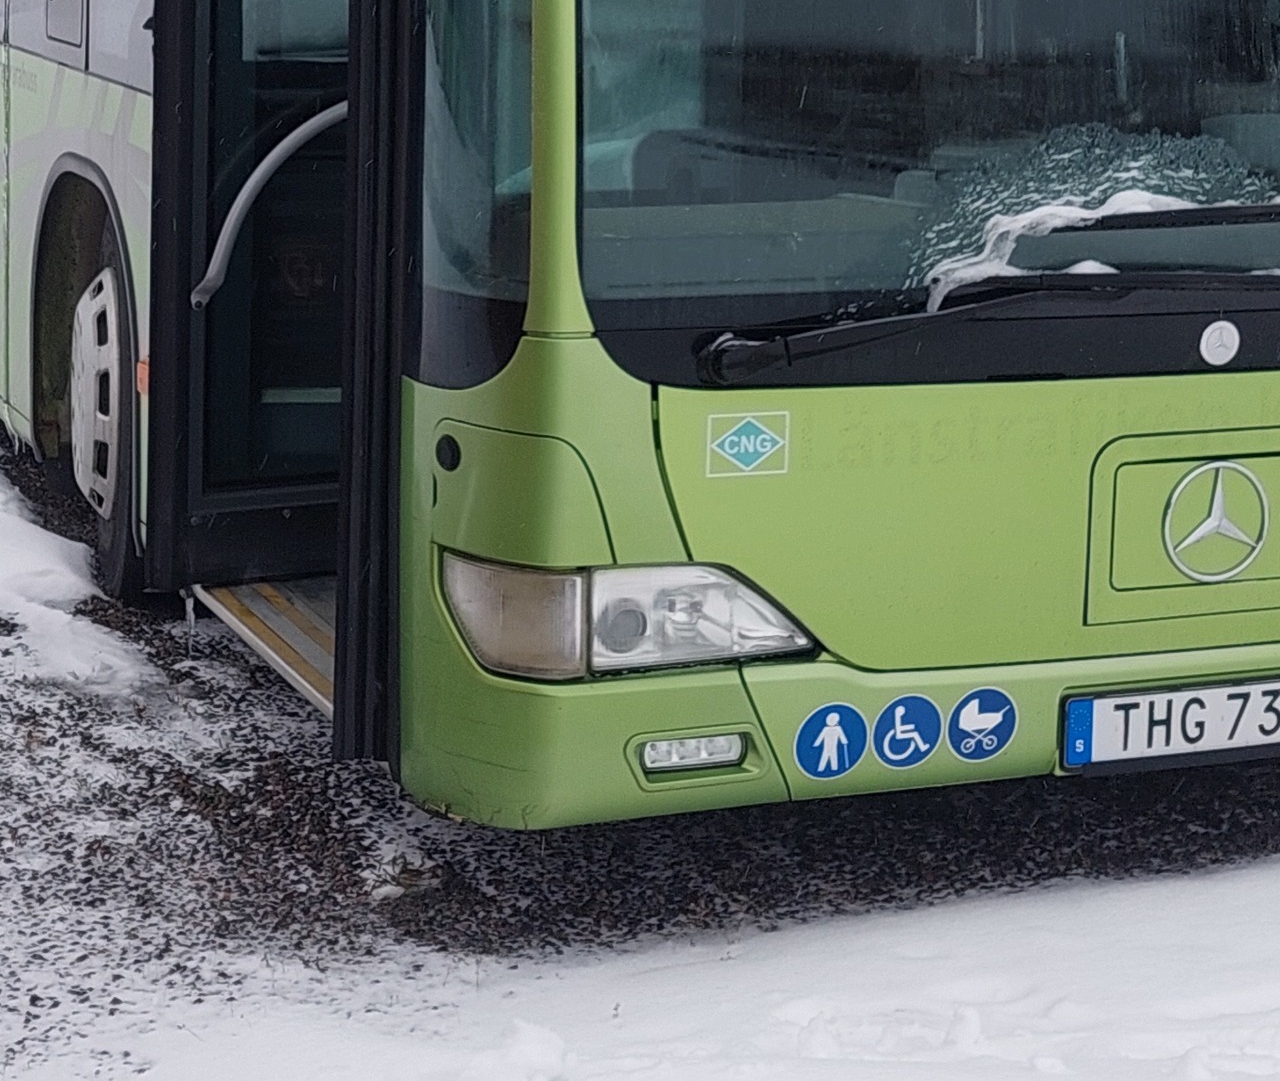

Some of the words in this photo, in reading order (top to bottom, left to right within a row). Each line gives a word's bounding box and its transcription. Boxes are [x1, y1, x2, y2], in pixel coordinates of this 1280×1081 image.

[723, 433, 773, 456] CNG
[1113, 696, 1207, 752] THG
[1075, 739, 1084, 753] S
